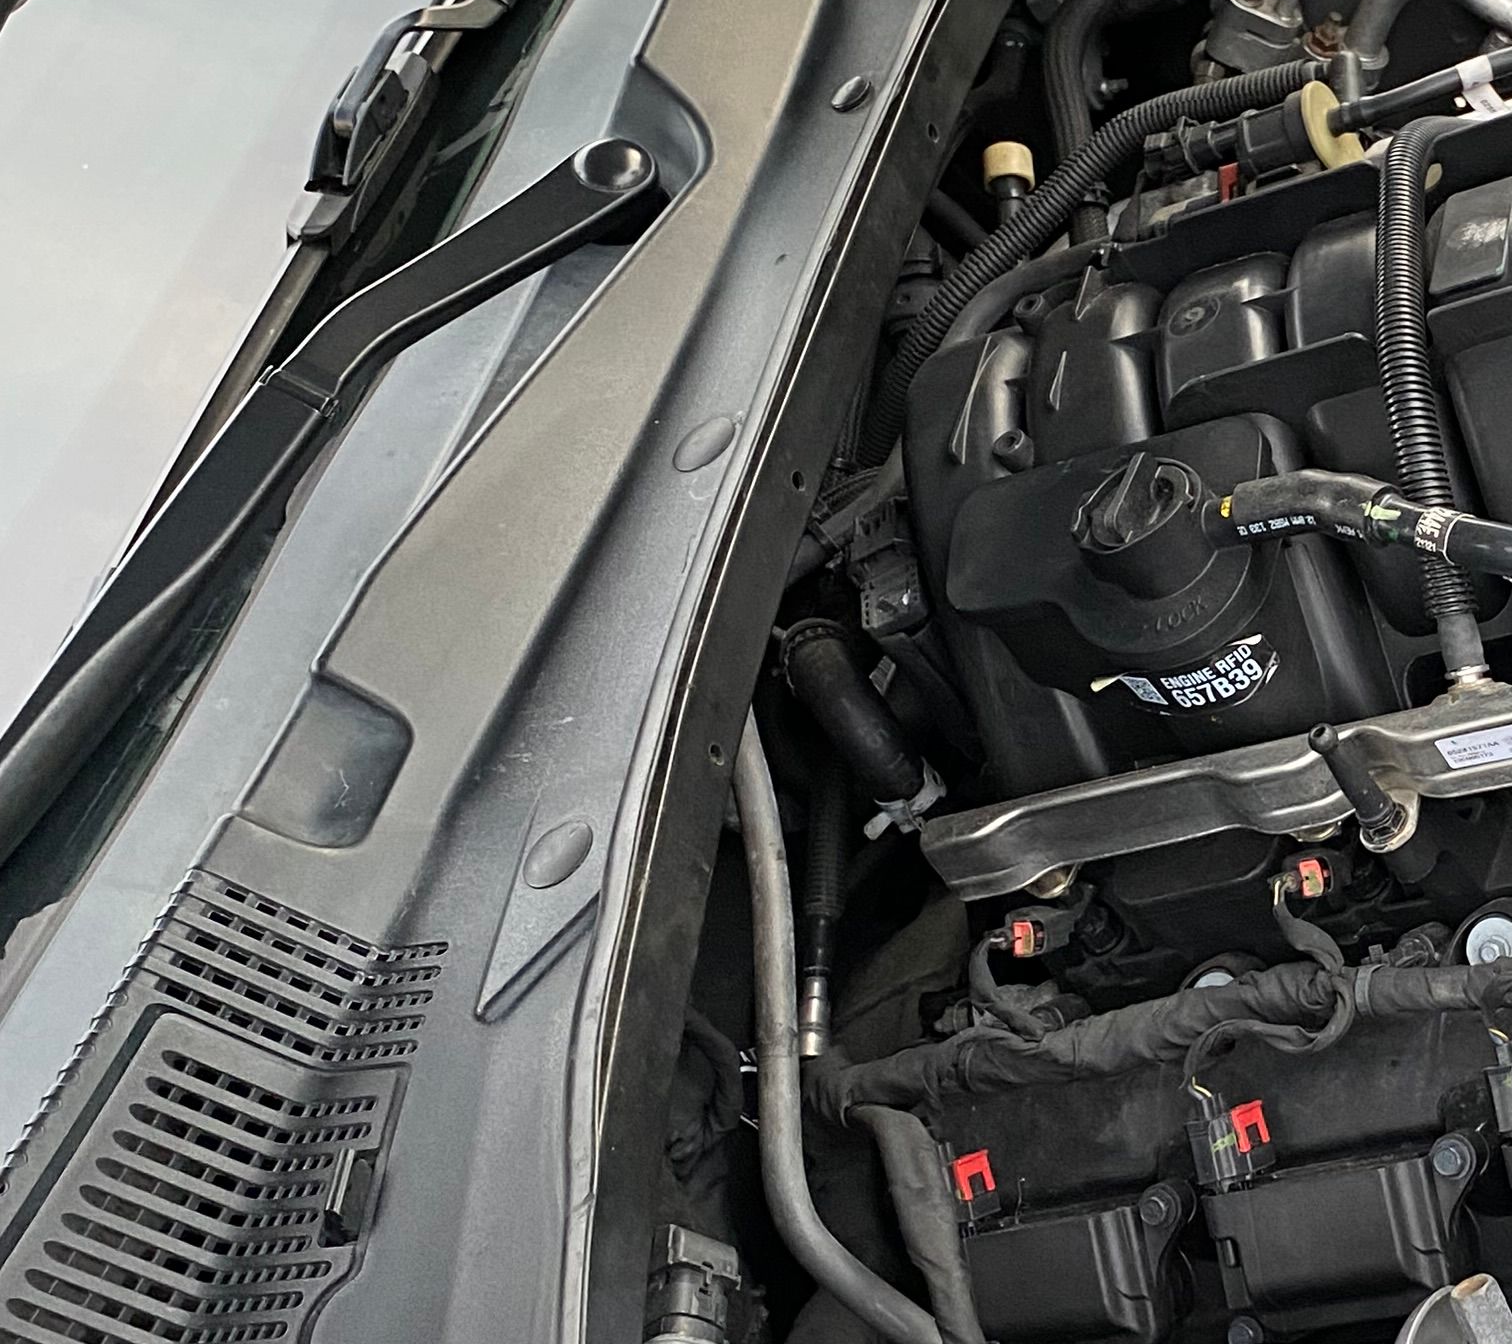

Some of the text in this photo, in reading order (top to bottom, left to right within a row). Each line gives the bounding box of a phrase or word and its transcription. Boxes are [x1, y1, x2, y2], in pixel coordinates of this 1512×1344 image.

[1160, 644, 1252, 690] ENGINE RFID
[1171, 658, 1263, 708] 657B39
